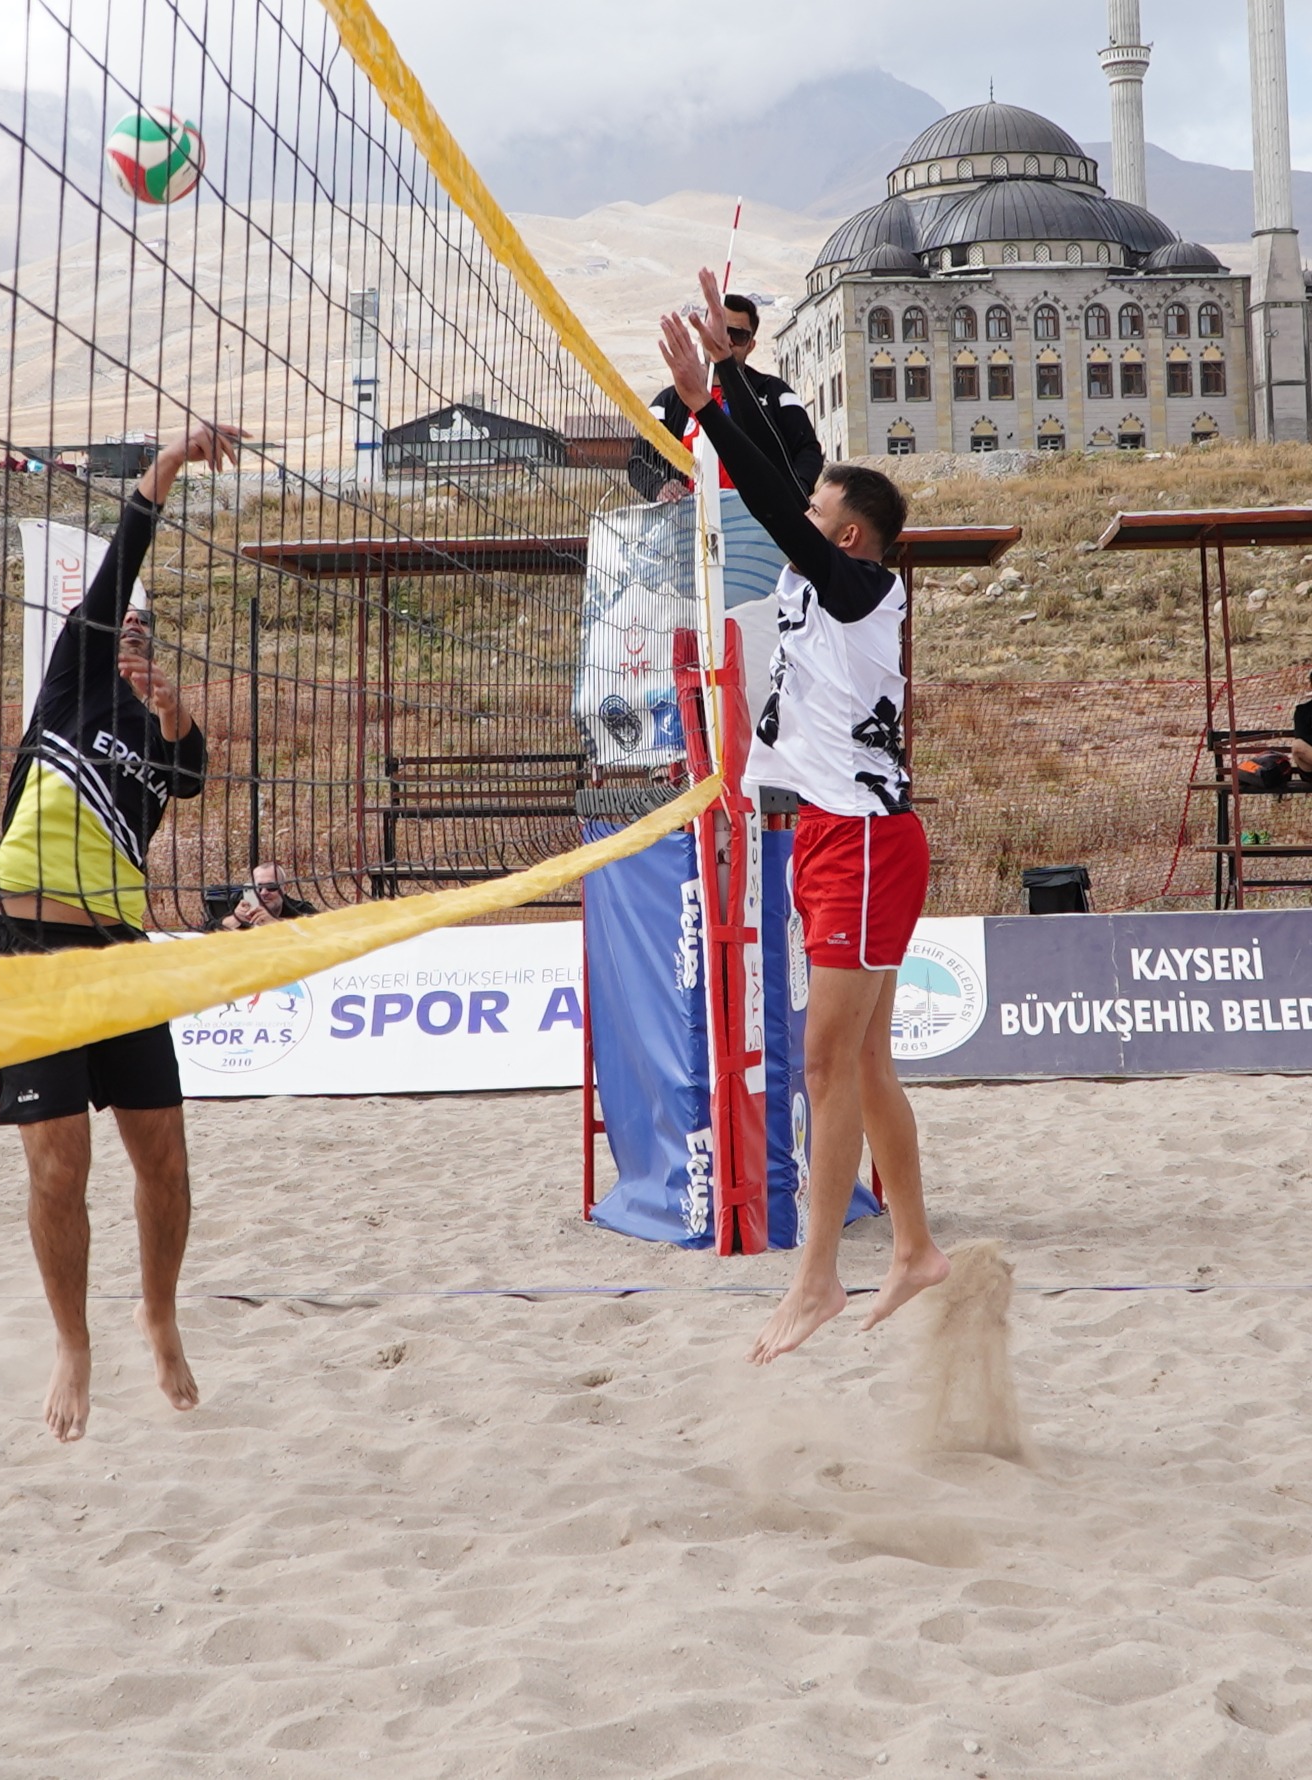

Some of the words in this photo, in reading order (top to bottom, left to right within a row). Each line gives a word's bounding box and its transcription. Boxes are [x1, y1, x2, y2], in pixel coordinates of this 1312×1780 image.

[1130, 937, 1265, 982] KAYSERİ
[332, 970, 410, 991] KAYSERİ
[416, 968, 536, 989] BÜYÜKŞEHİR
[329, 989, 510, 1040] SPOR
[999, 990, 1215, 1042] BÜYÜKŞEHİR
[181, 1028, 244, 1046] SPOR
[253, 1028, 297, 1047] A.Ş.
[893, 1041, 929, 1052] 1869
[221, 1058, 252, 1067] 2010
